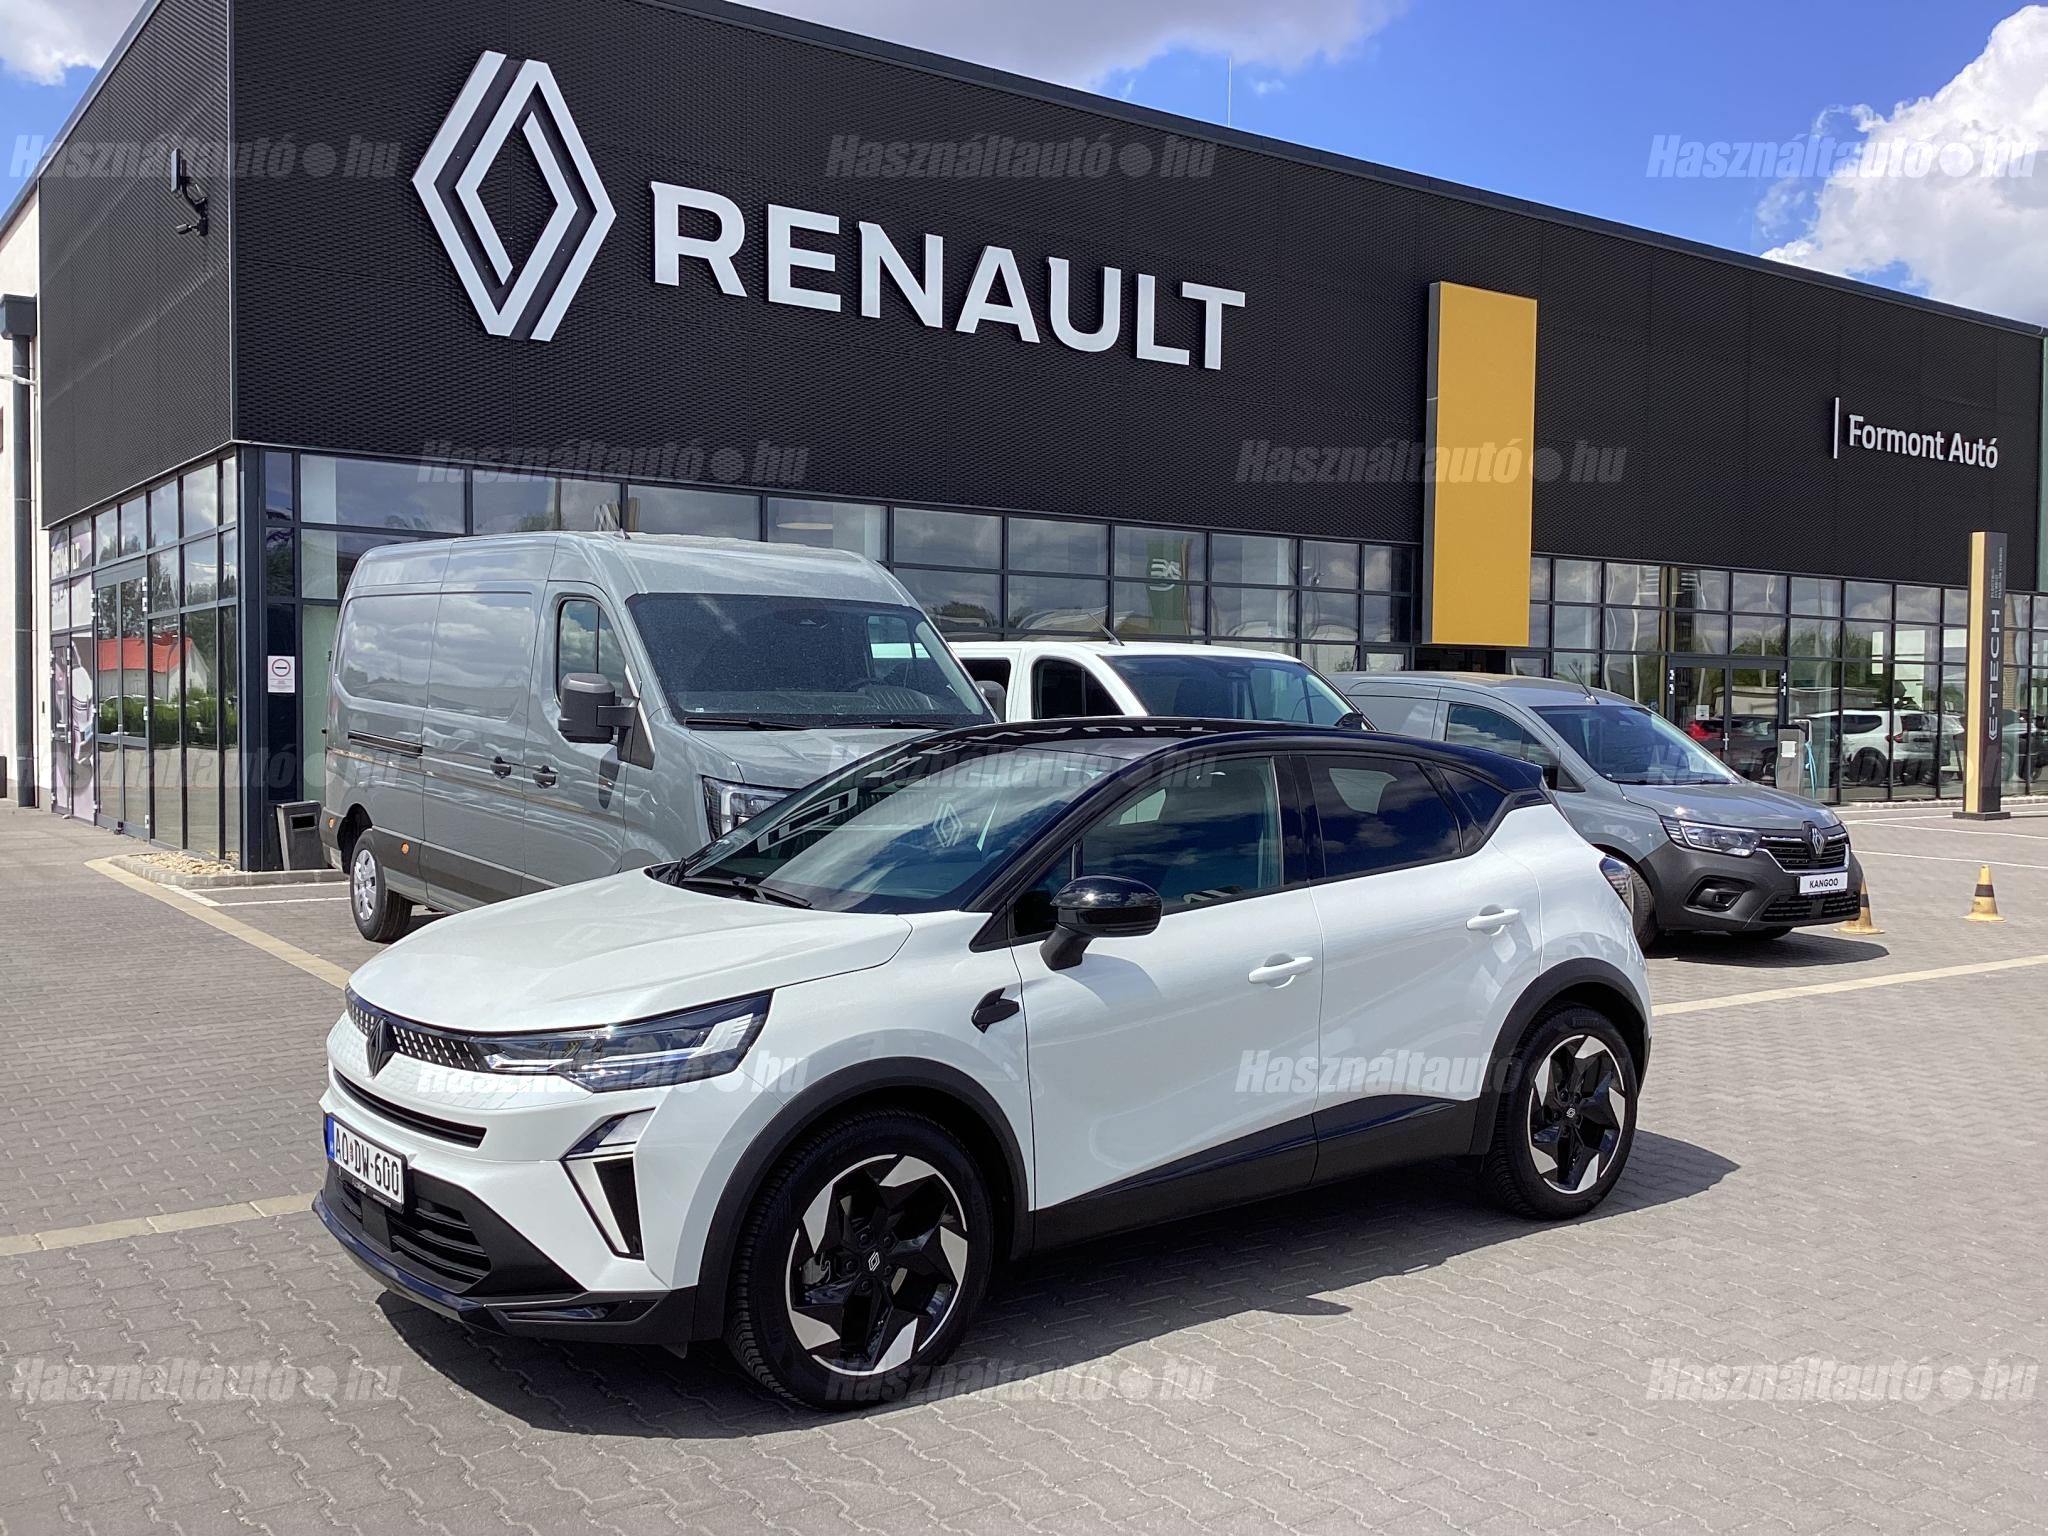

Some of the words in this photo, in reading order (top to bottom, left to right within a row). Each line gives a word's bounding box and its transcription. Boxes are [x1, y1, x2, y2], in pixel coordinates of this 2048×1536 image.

[650, 180, 1246, 371] RENAULT
[1849, 414, 1945, 461] Formont
[1948, 432, 1999, 469] Autó
[1988, 609, 2000, 740] E-TECH
[1809, 878, 1839, 889] KANGOO
[354, 1139, 399, 1196] DW-600
